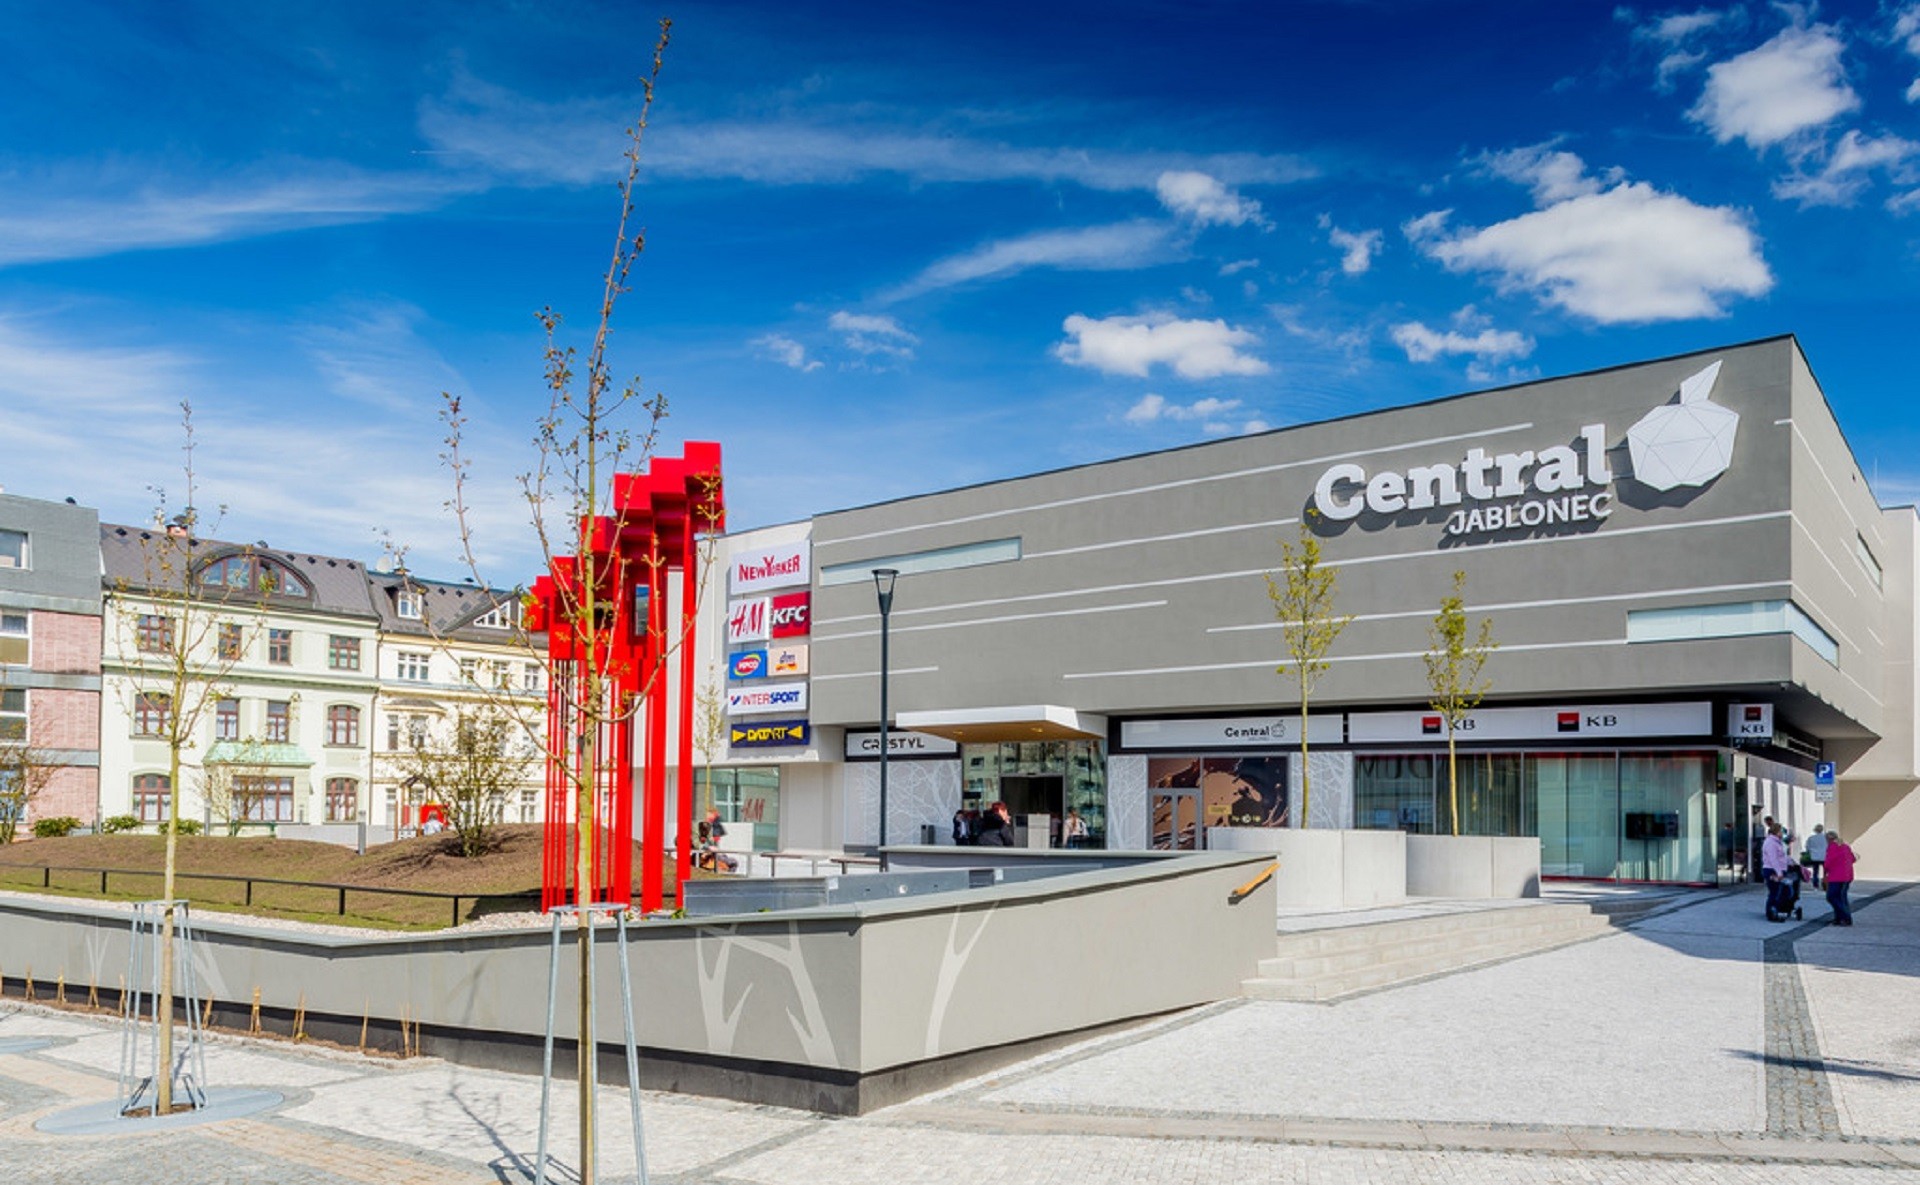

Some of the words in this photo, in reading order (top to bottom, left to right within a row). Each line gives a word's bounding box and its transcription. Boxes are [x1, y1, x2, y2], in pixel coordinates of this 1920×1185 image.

[1314, 422, 1613, 521] Central
[1449, 493, 1614, 536] JABLONEC
[773, 605, 808, 624] KFC
[741, 690, 800, 705] INTERSPORT
[1587, 715, 1618, 727] KB
[1224, 726, 1270, 738] Central
[1740, 724, 1765, 734] KB
[861, 736, 925, 750] CRSTYL
[1818, 764, 1831, 778] P
